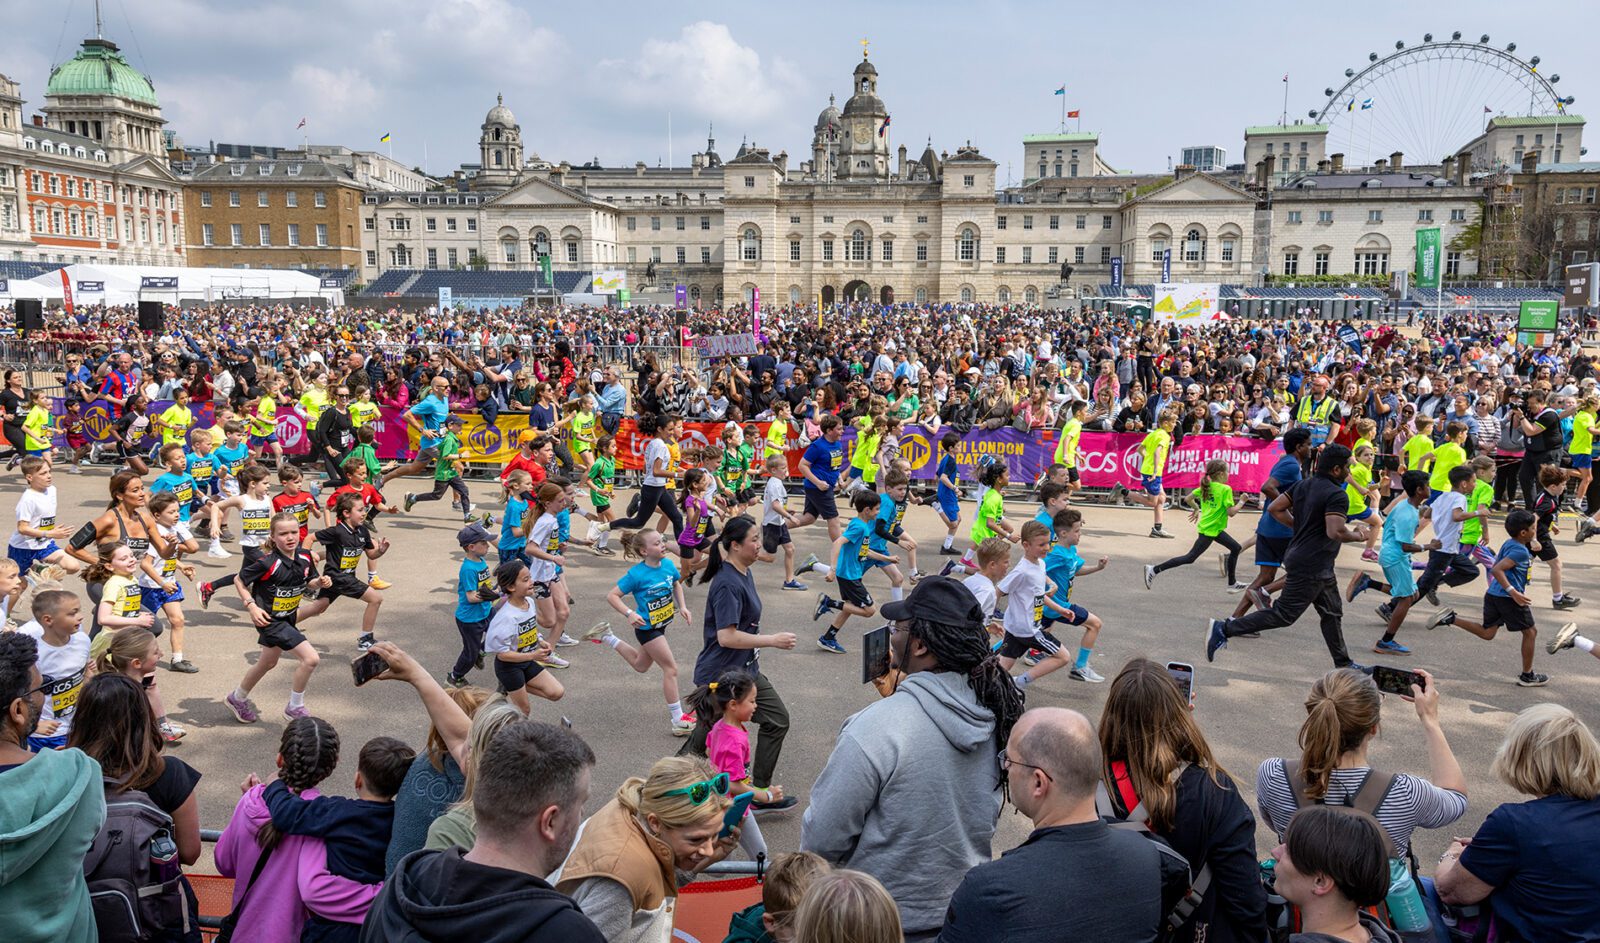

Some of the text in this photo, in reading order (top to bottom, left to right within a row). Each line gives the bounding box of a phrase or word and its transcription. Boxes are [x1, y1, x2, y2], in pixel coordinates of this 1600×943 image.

[971, 441, 1024, 455] LONDON
[1076, 446, 1259, 473] tcs MINI LONDON
[1168, 461, 1239, 475] MARAN
[276, 588, 291, 597] tcs
